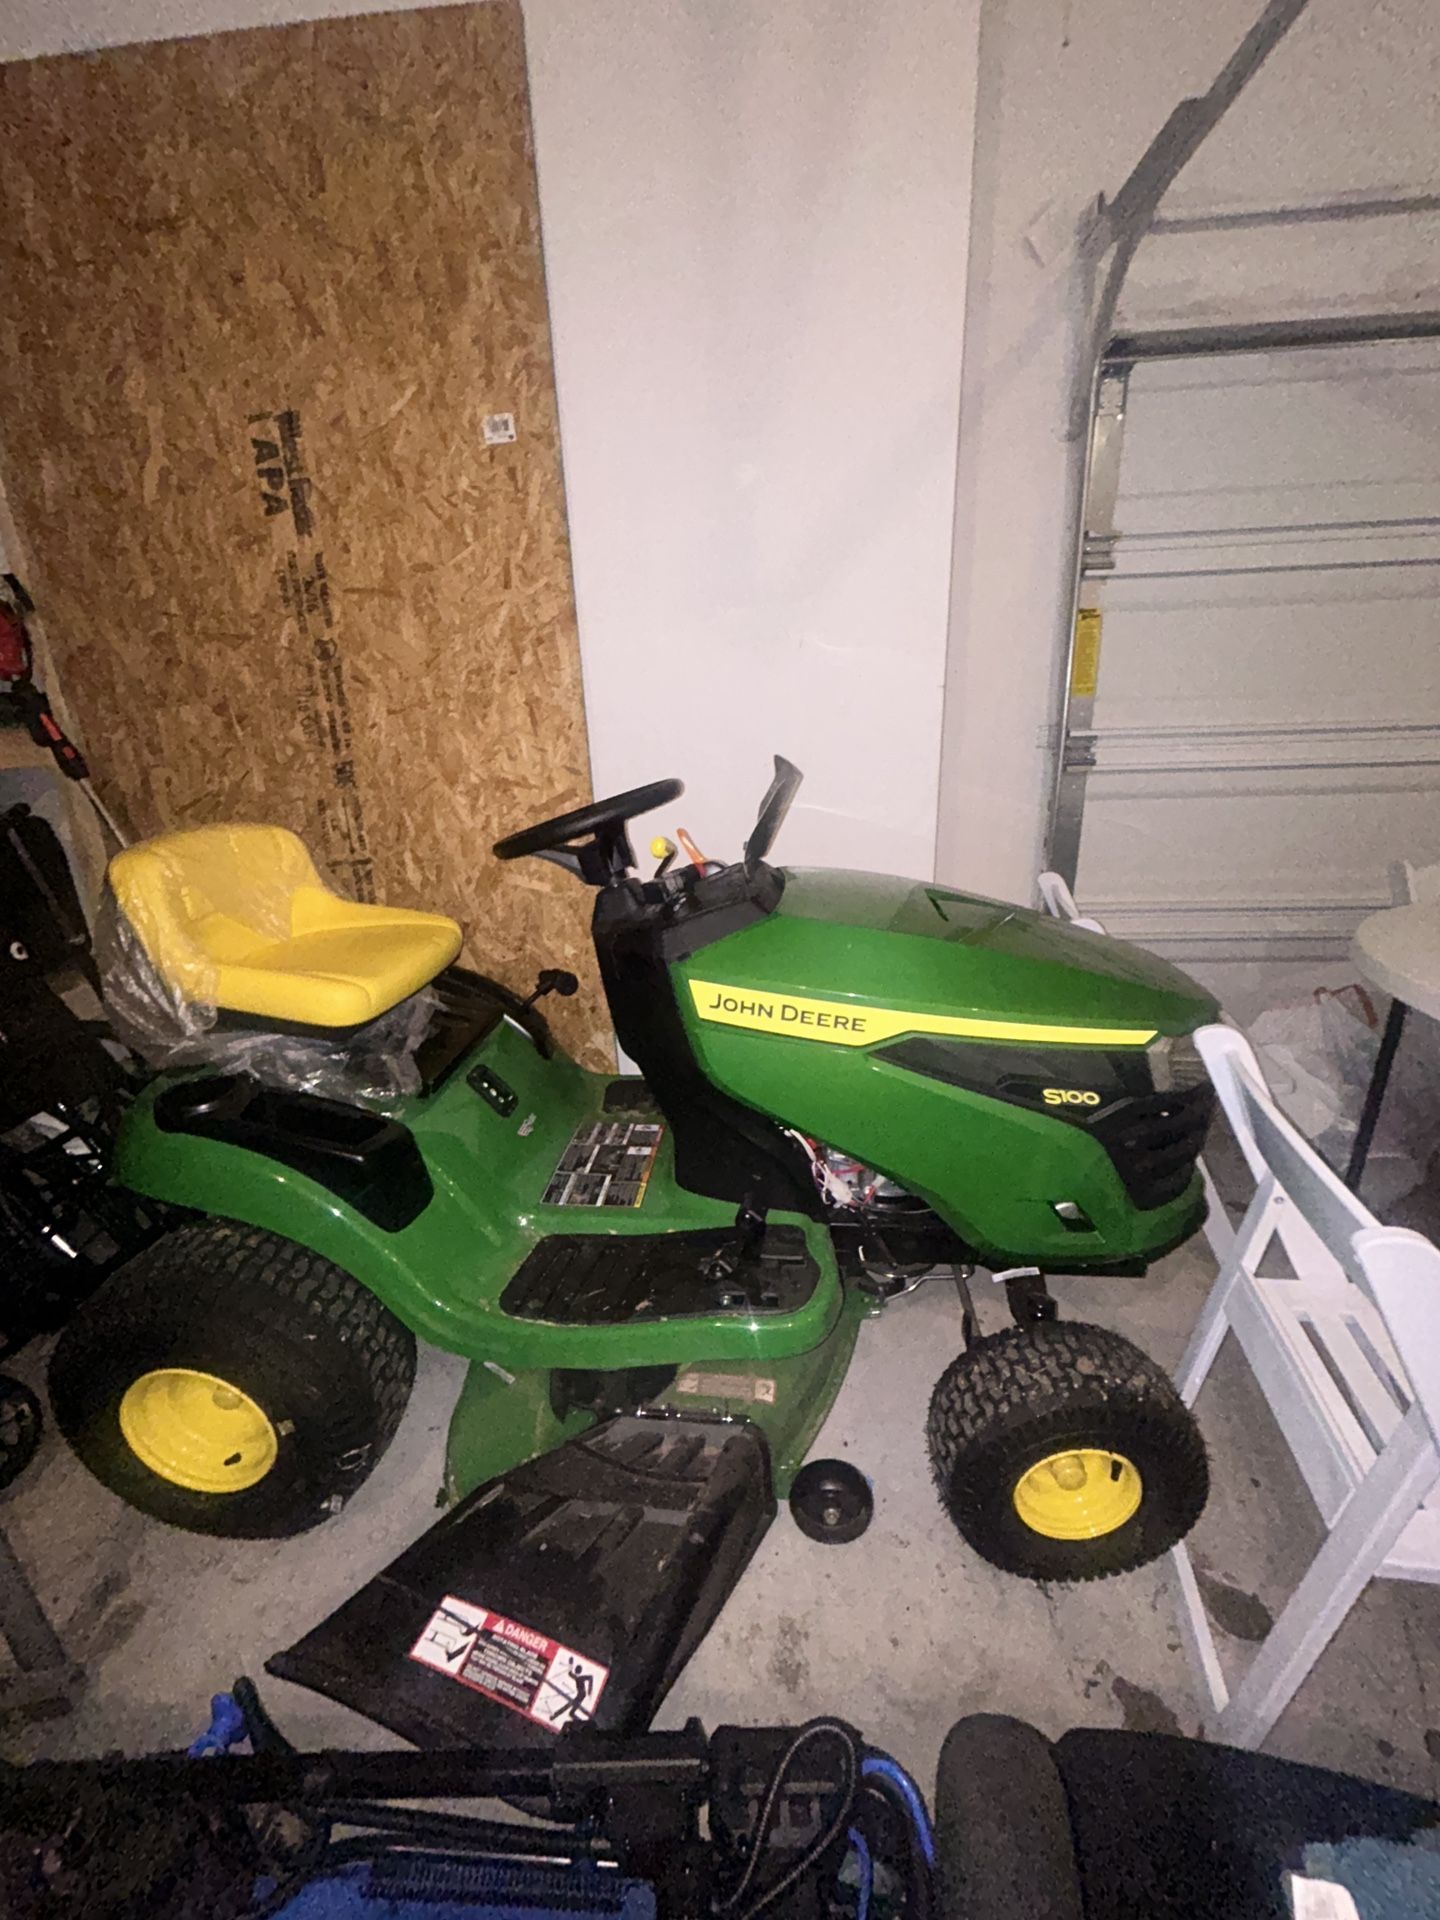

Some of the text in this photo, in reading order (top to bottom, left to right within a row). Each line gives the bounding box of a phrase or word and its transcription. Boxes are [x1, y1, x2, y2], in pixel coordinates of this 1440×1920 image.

[249, 437, 289, 517] APA
[709, 993, 867, 1032] JOHN DEERE
[1042, 1088, 1101, 1105] S100
[504, 1623, 549, 1653] DANGER
